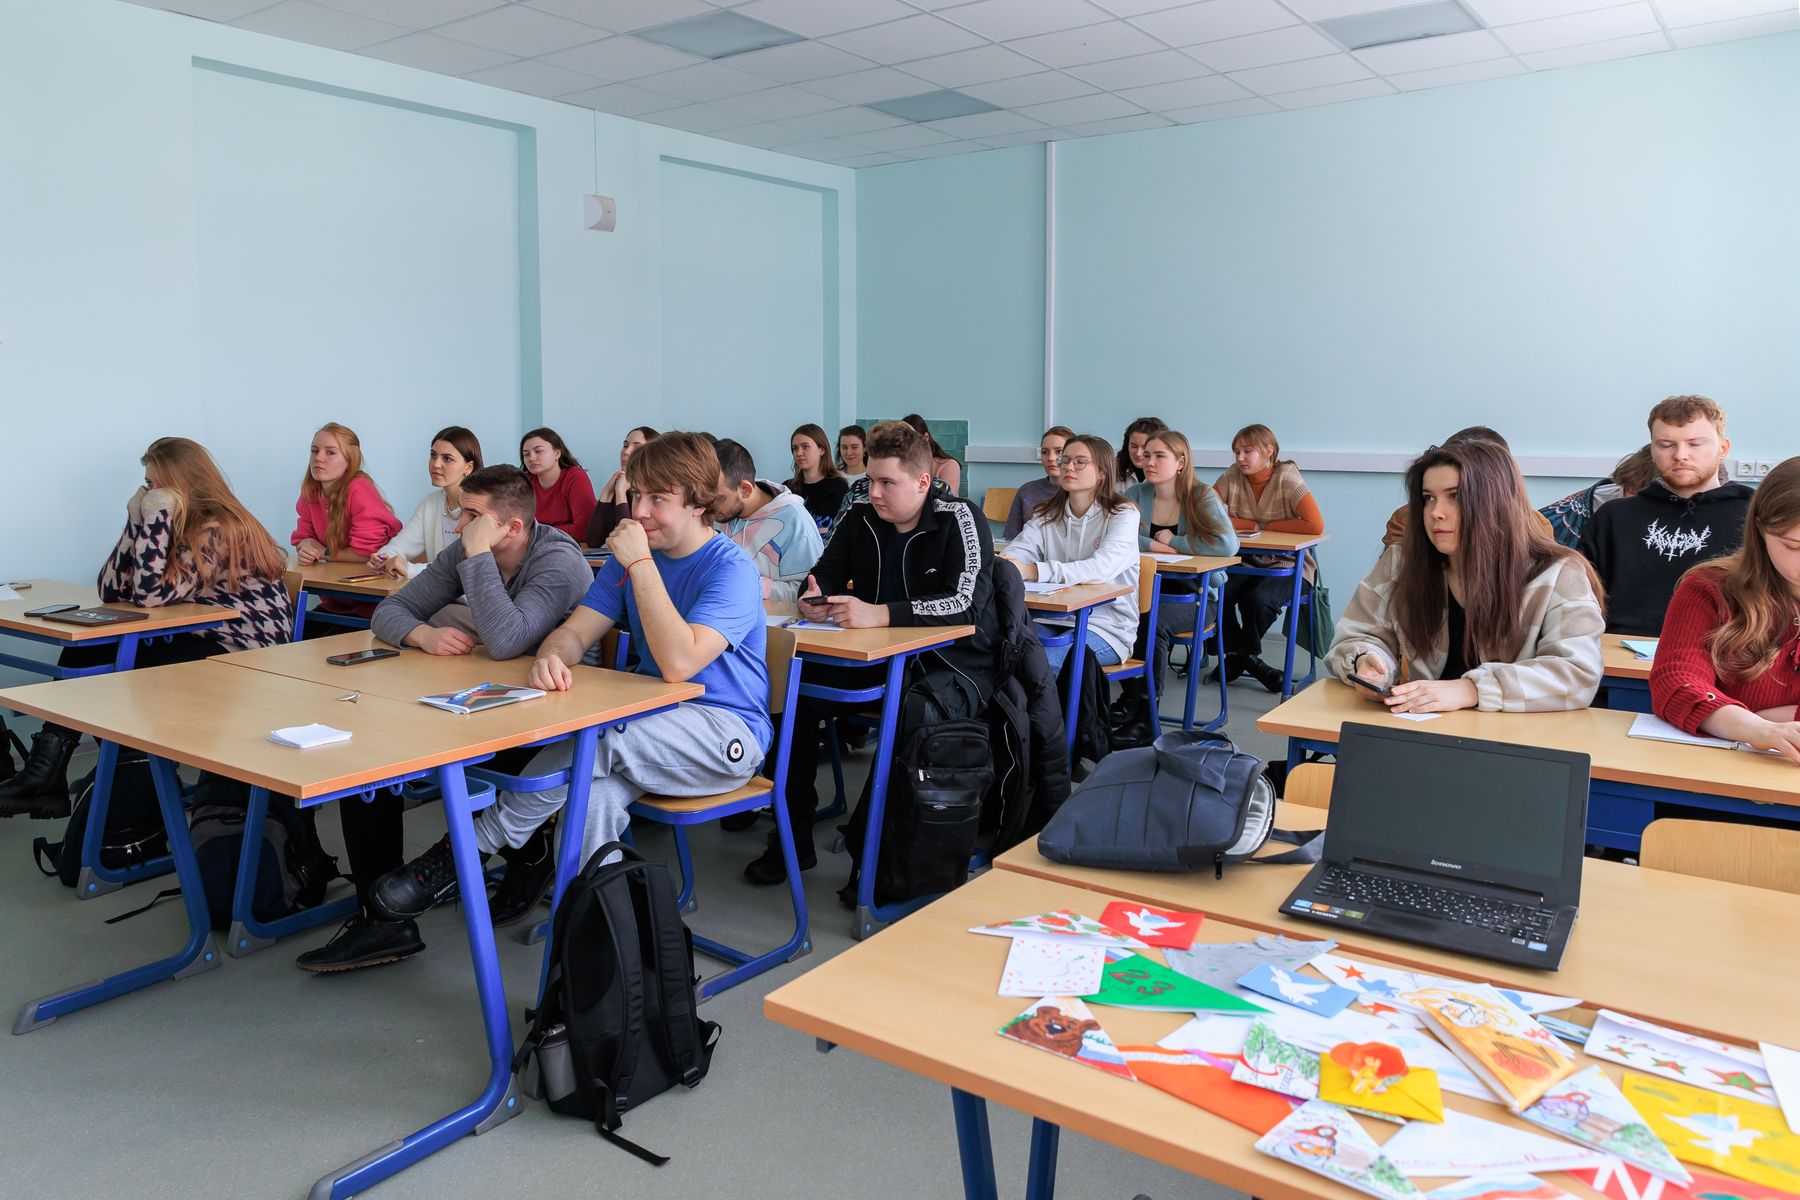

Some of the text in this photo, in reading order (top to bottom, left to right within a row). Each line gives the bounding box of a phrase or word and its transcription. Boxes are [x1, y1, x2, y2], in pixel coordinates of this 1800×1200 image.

[962, 520, 977, 551] RULES
[960, 576, 972, 591] ALL
[1430, 859, 1462, 870] lenovo
[1108, 969, 1176, 996] 23
